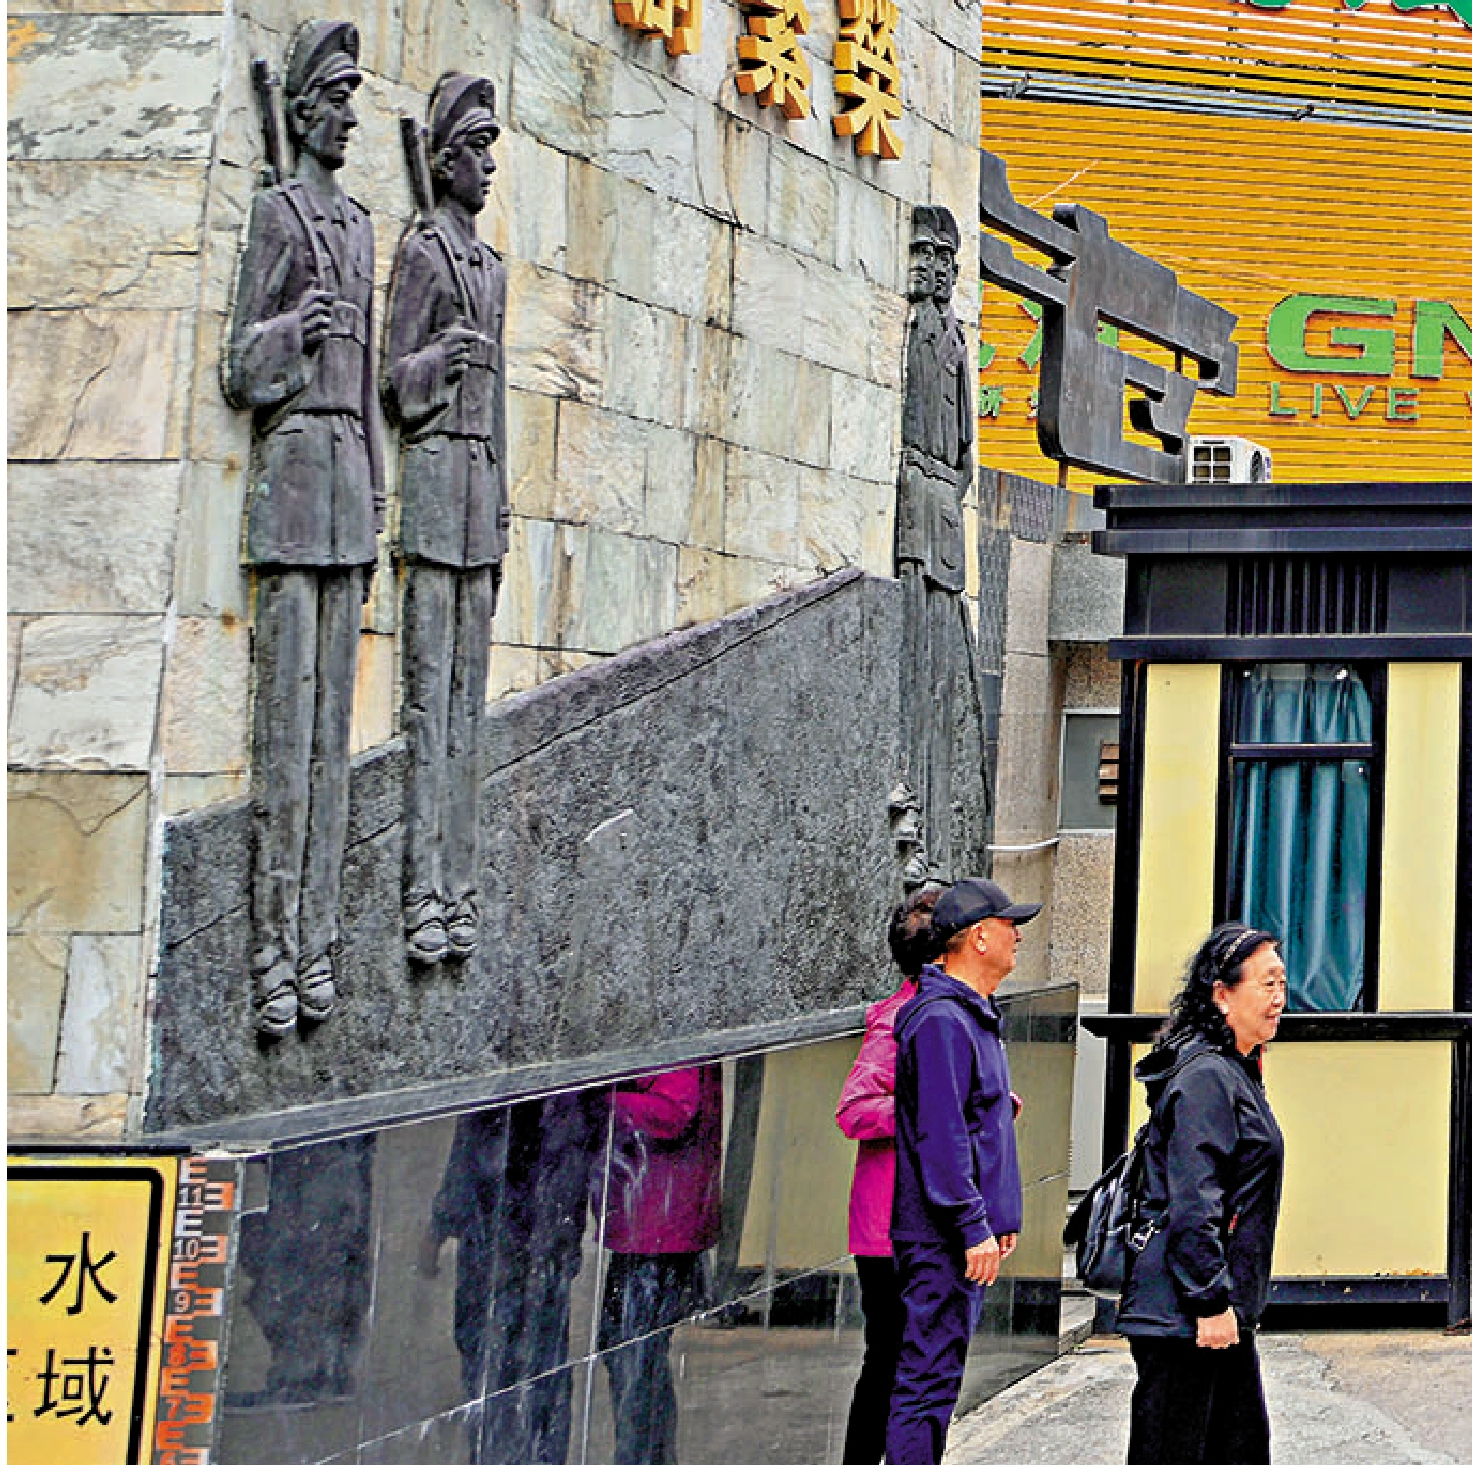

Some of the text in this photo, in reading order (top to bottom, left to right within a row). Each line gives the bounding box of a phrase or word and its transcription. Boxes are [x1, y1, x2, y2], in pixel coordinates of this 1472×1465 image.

[1268, 381, 1420, 424] LIVE
[178, 1187, 203, 1207] 11
[174, 1239, 199, 1261] 10
[39, 1231, 118, 1316] 水
[173, 1291, 191, 1313] 9
[7, 1347, 116, 1426] 域
[165, 1398, 182, 1421] 7
